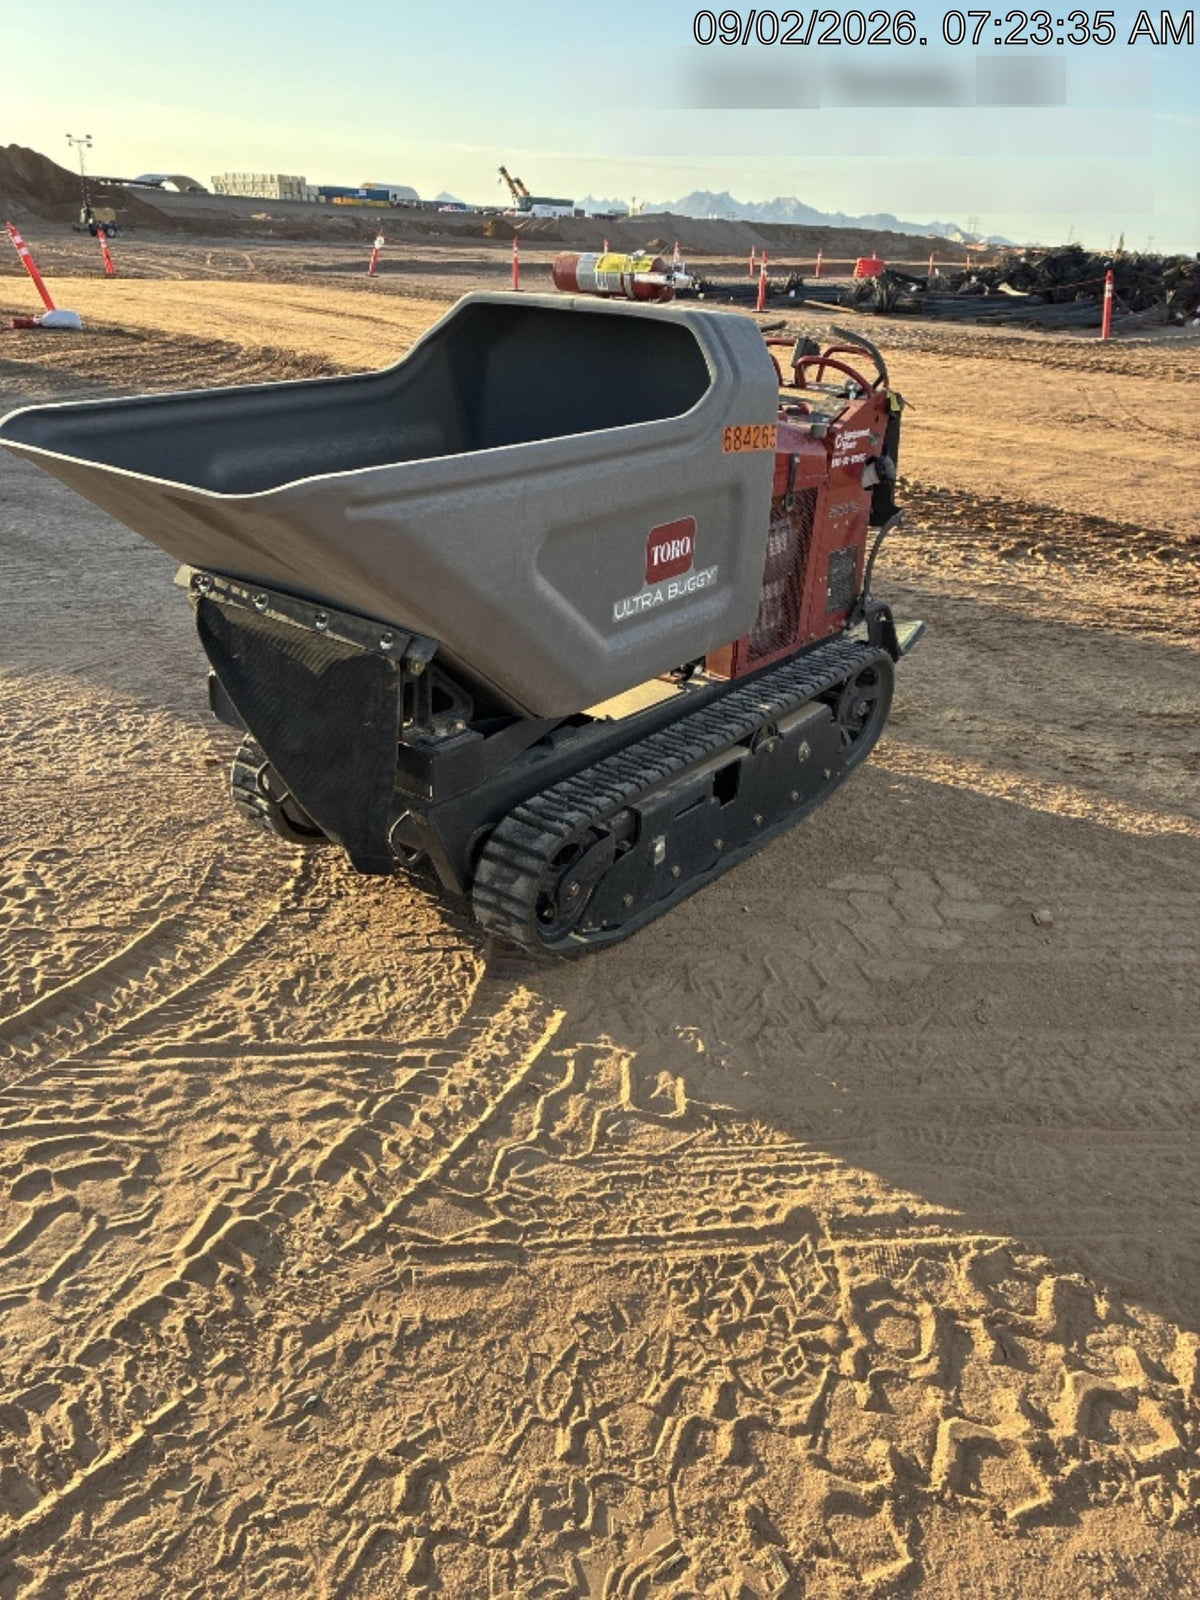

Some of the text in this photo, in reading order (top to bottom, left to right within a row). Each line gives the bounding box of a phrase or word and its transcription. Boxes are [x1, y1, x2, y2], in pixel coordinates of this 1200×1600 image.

[652, 536, 691, 566] TORO
[612, 566, 715, 621] ULTRA BUGGY
